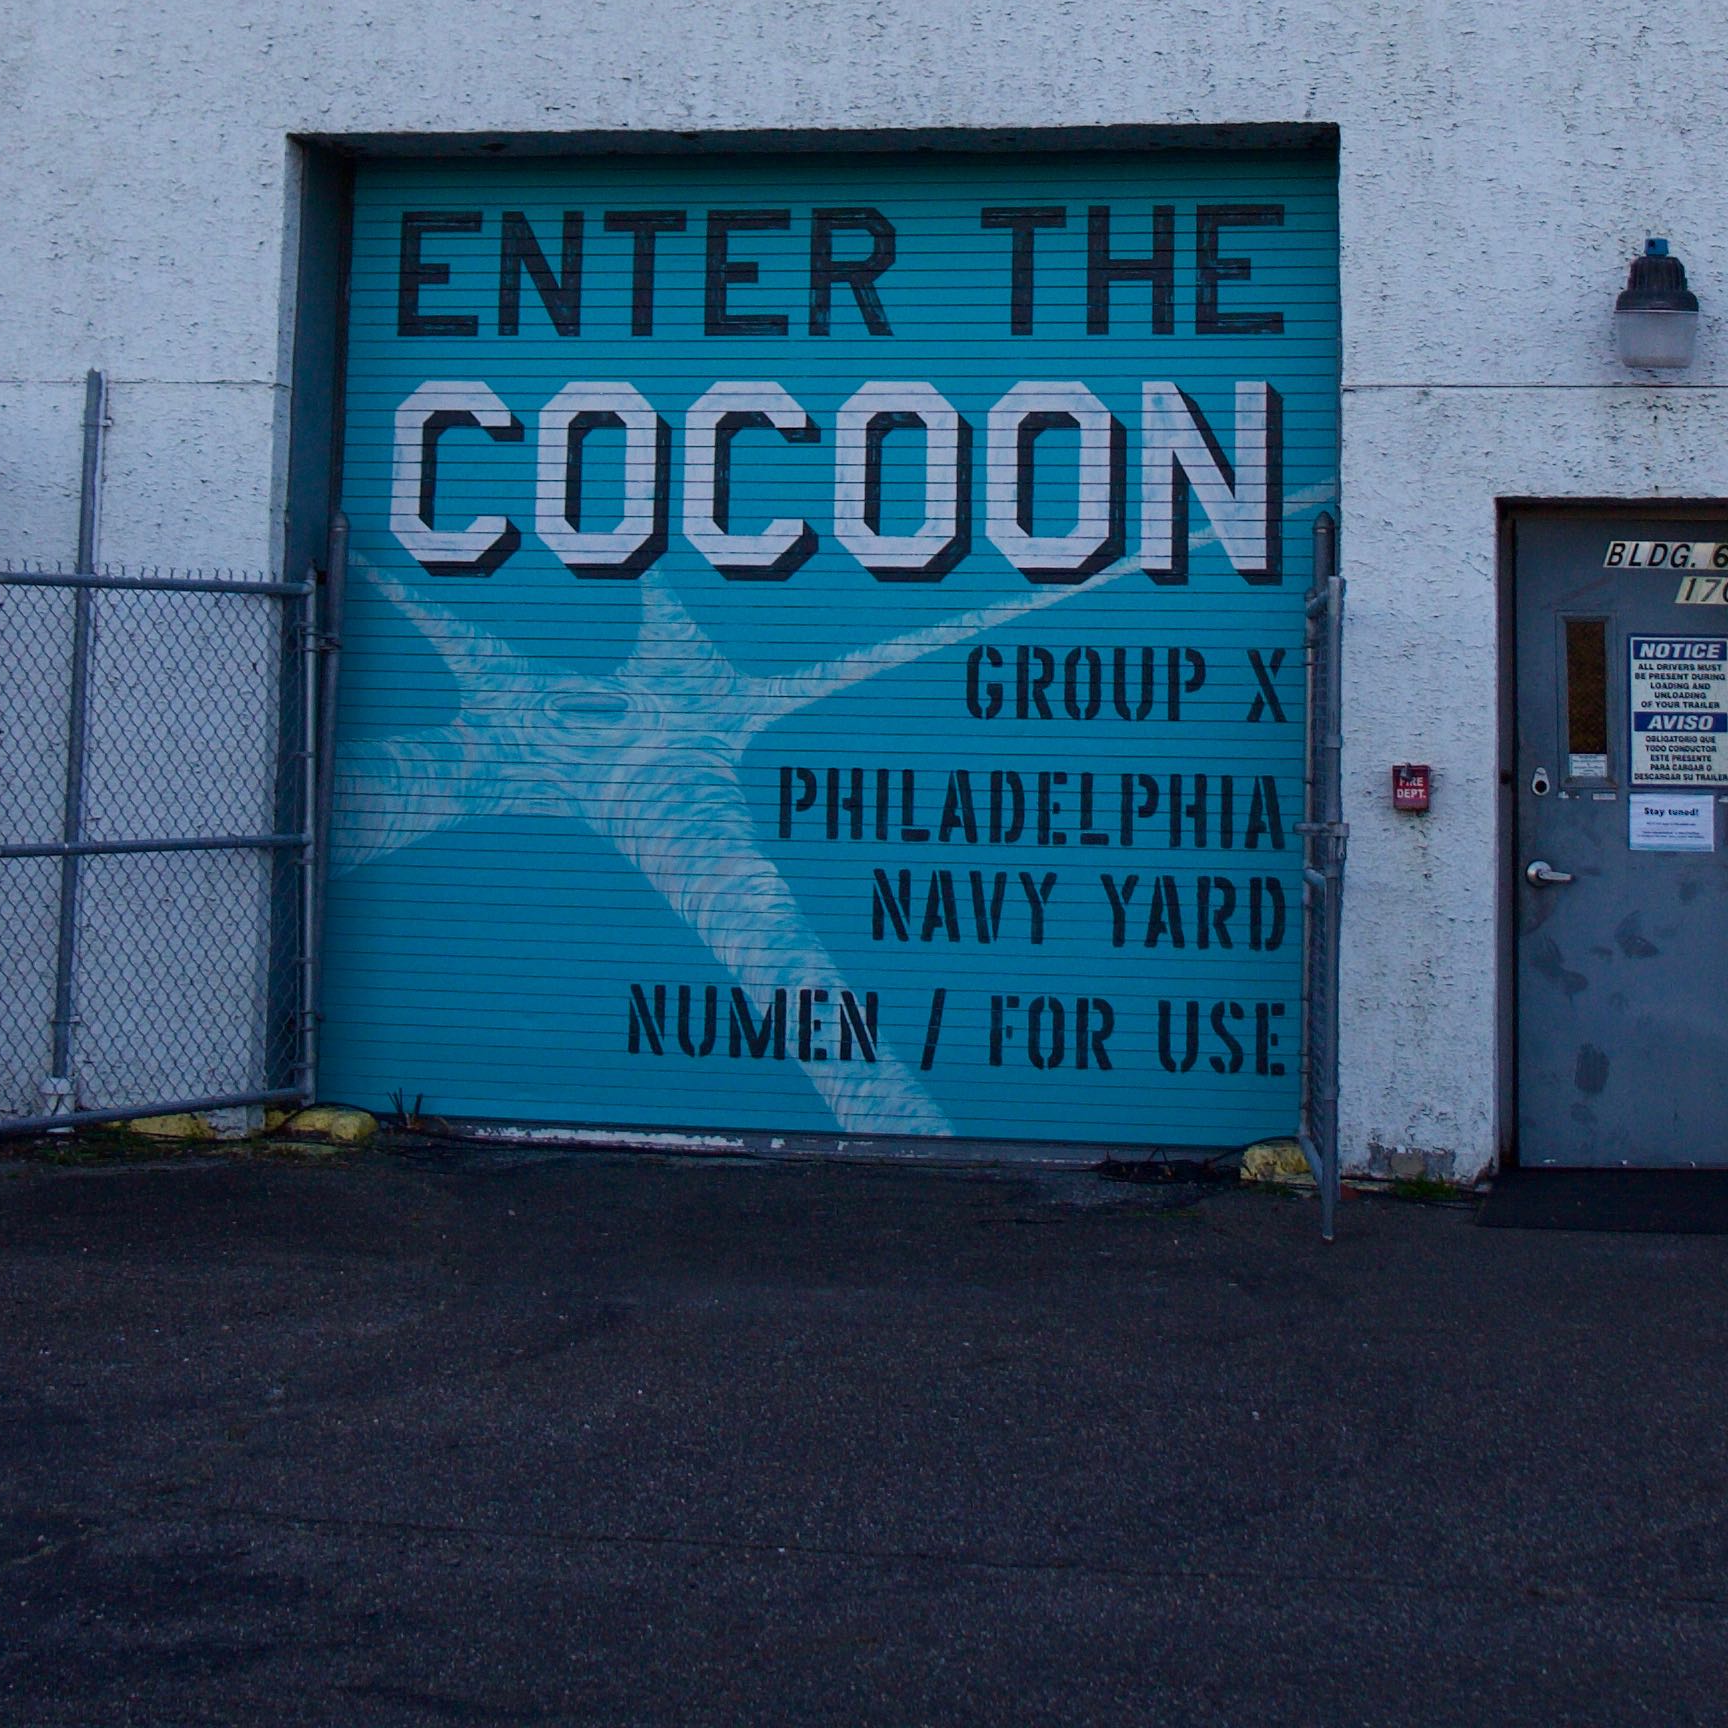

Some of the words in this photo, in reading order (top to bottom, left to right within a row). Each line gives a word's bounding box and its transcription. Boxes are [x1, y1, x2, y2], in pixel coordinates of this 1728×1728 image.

[397, 206, 897, 337] ENTER
[980, 204, 1285, 336] THE
[389, 380, 1284, 586] COCOON
[1606, 542, 1696, 568] BLDG.
[1638, 642, 1721, 659] NOTICE
[1638, 663, 1653, 671] ALL
[1656, 663, 1695, 671] DRIVERS
[1691, 673, 1726, 681] DURING
[965, 644, 1207, 723] GROUP
[1246, 647, 1287, 724] X
[1650, 682, 1690, 690] LOADING
[1655, 701, 1680, 709] YOUR
[1683, 701, 1720, 709] TRAILER
[1647, 714, 1714, 730] AVISO
[1645, 735, 1697, 743] OBLIGATORIO
[1699, 736, 1716, 744] QUE
[1650, 754, 1670, 762] ESTE
[1672, 754, 1712, 762] PRESENTE
[1634, 773, 1681, 781] DESCARGAR
[1683, 773, 1694, 781] SU
[1396, 788, 1427, 799] DEPT.
[778, 766, 1286, 850] PHILADELPHIA
[1643, 807, 1665, 817] Stay
[1668, 808, 1699, 817] tuned!
[872, 867, 1058, 946] NAVY
[1099, 874, 1287, 952] YARD
[627, 983, 879, 1063] NUMEN
[920, 987, 947, 1071] /
[988, 994, 1115, 1071] FOR
[1157, 999, 1287, 1076] USE
